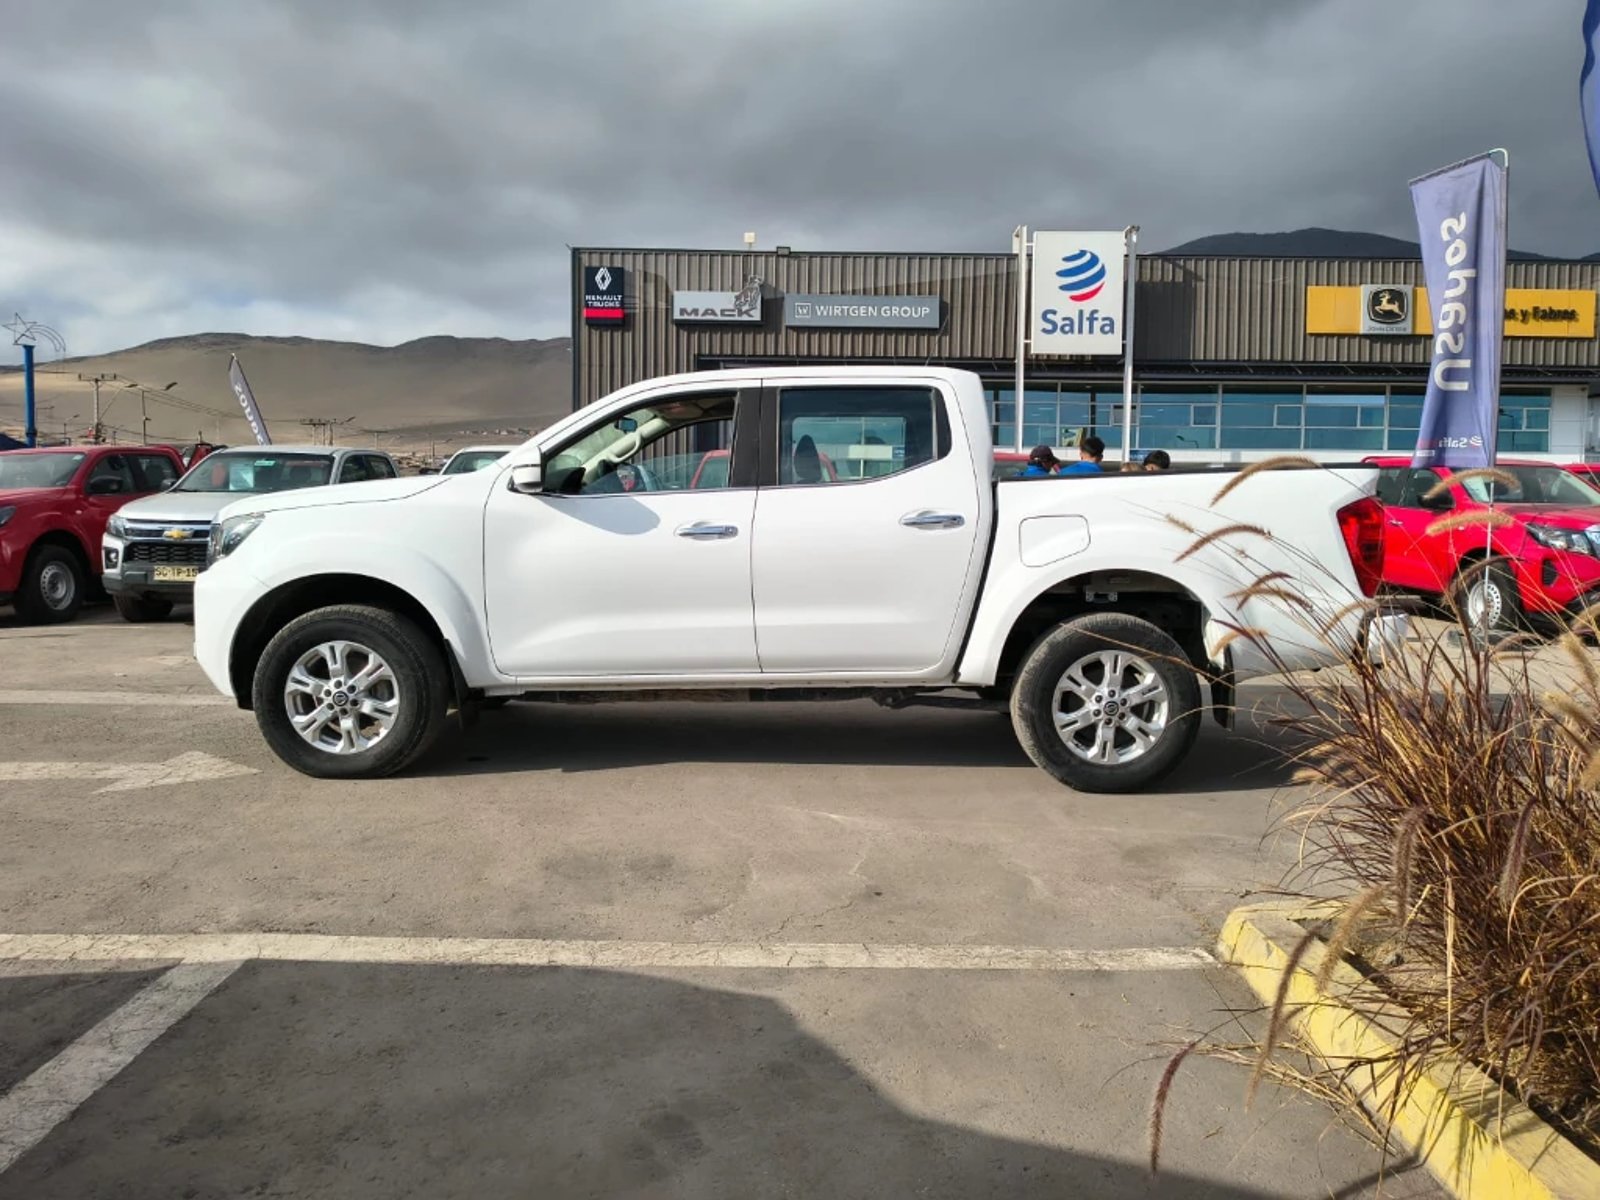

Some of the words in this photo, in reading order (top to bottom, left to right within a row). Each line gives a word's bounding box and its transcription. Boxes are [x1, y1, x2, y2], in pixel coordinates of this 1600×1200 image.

[679, 307, 755, 318] MACK
[815, 305, 878, 317] WIRTGEN
[881, 306, 930, 318] GROUP
[1041, 308, 1115, 335] Salfa
